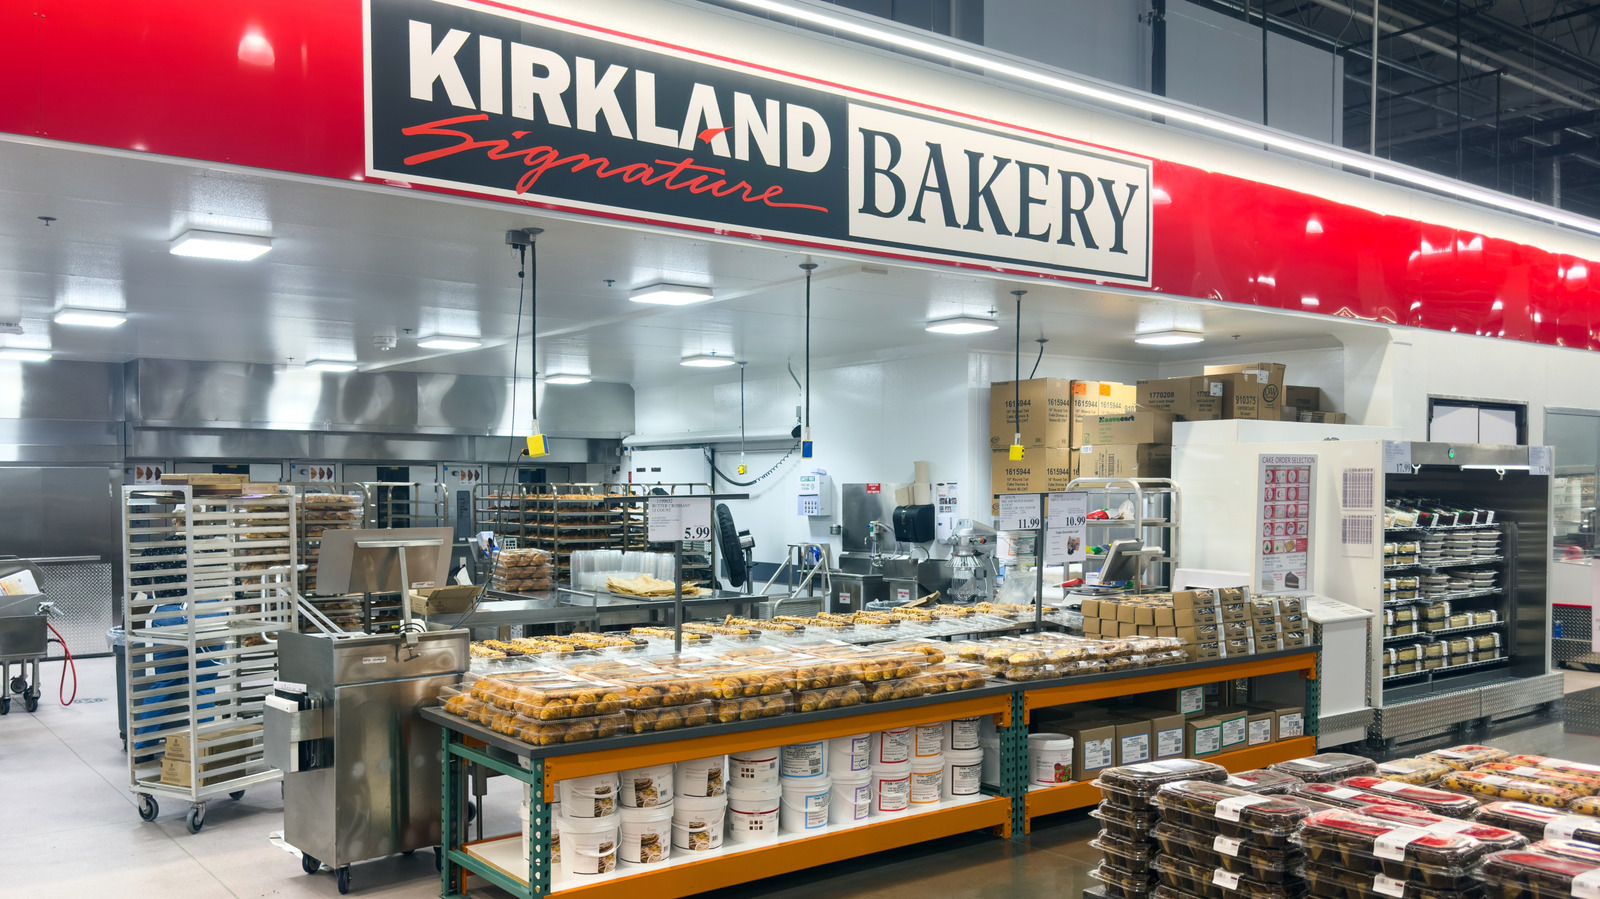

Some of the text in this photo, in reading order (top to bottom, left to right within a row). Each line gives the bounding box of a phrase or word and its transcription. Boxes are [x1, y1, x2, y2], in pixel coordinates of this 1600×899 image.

[408, 18, 1139, 255] KIRKLAND BAKERY
[400, 113, 829, 214] Signature
[1048, 398, 1070, 406] 1615944
[1074, 400, 1098, 408] 1615944
[1236, 395, 1256, 404] 910375
[1396, 463, 1410, 472] 17.99
[1018, 518, 1040, 528] 11.99
[1066, 516, 1086, 526] 10.99
[684, 527, 710, 539] 5.99
